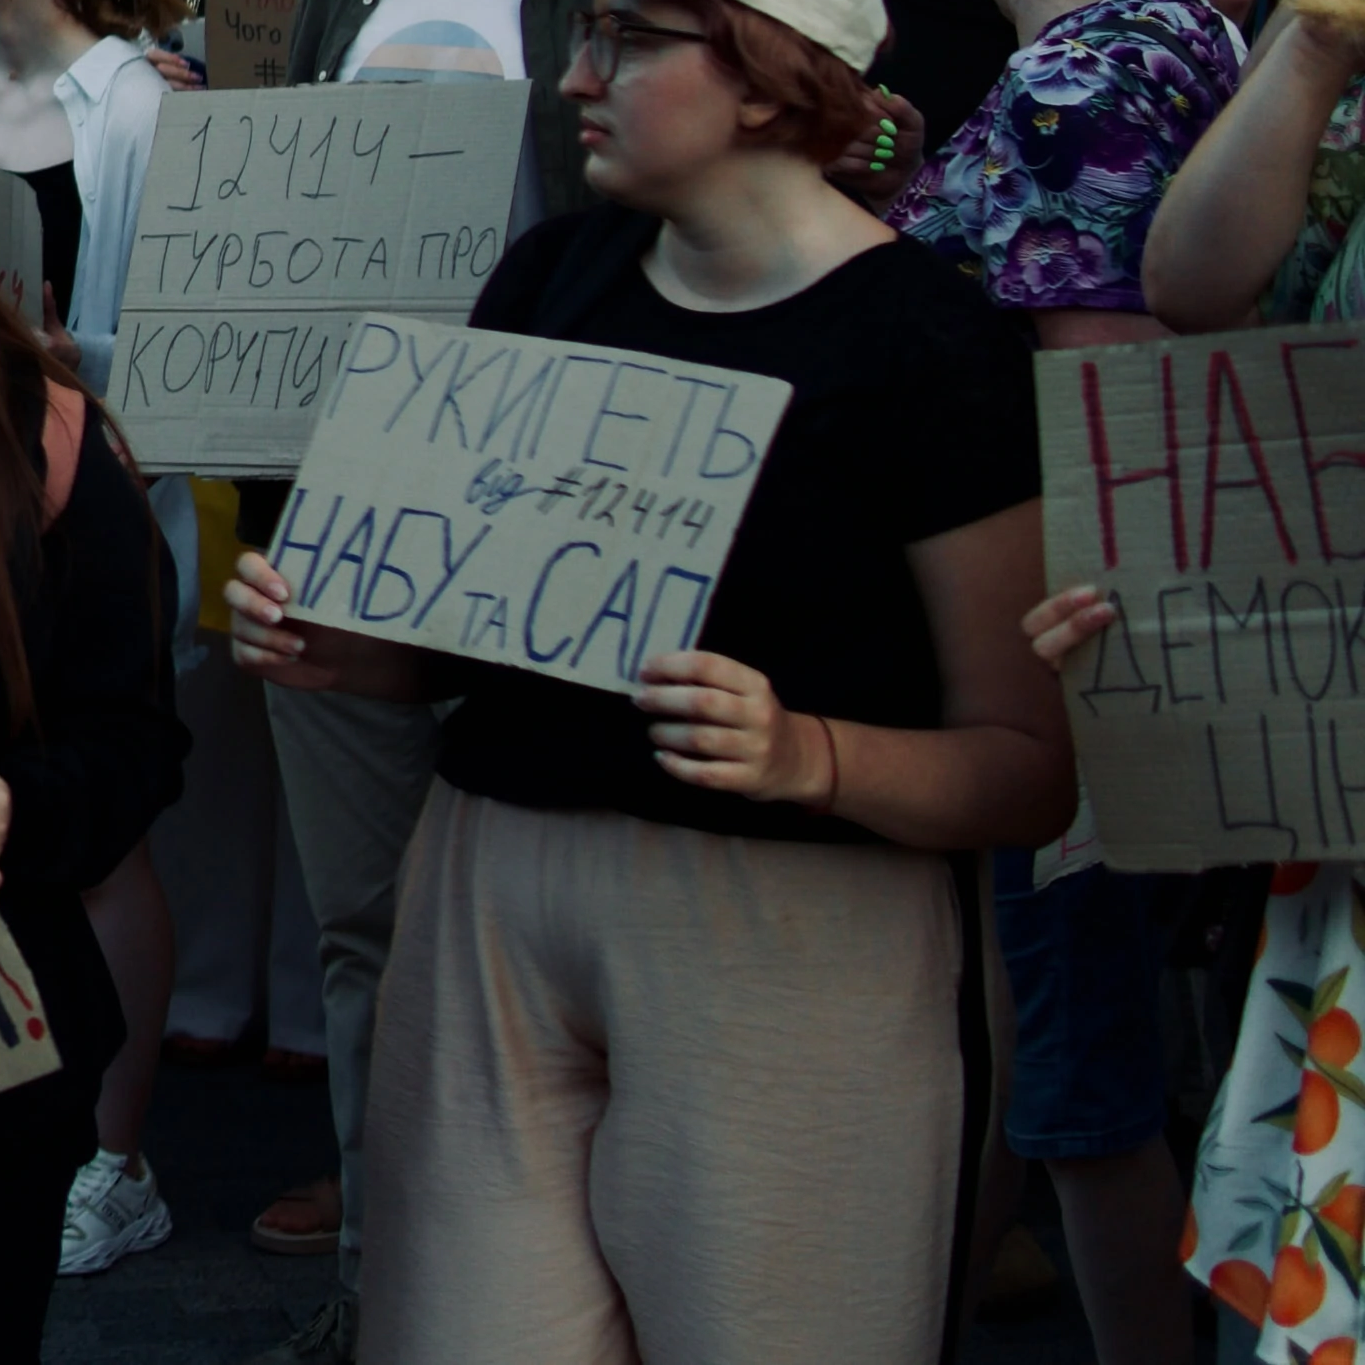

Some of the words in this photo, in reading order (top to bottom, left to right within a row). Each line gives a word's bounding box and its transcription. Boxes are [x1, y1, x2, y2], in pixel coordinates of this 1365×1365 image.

[166, 114, 391, 211] 12414
[140, 229, 389, 295] ТУРБОТА
[417, 225, 498, 281] ПРО
[122, 320, 354, 413] КОРУПЦІ
[327, 322, 558, 462] РУКИ
[272, 487, 493, 631] НАБУ
[522, 540, 714, 684] САП
